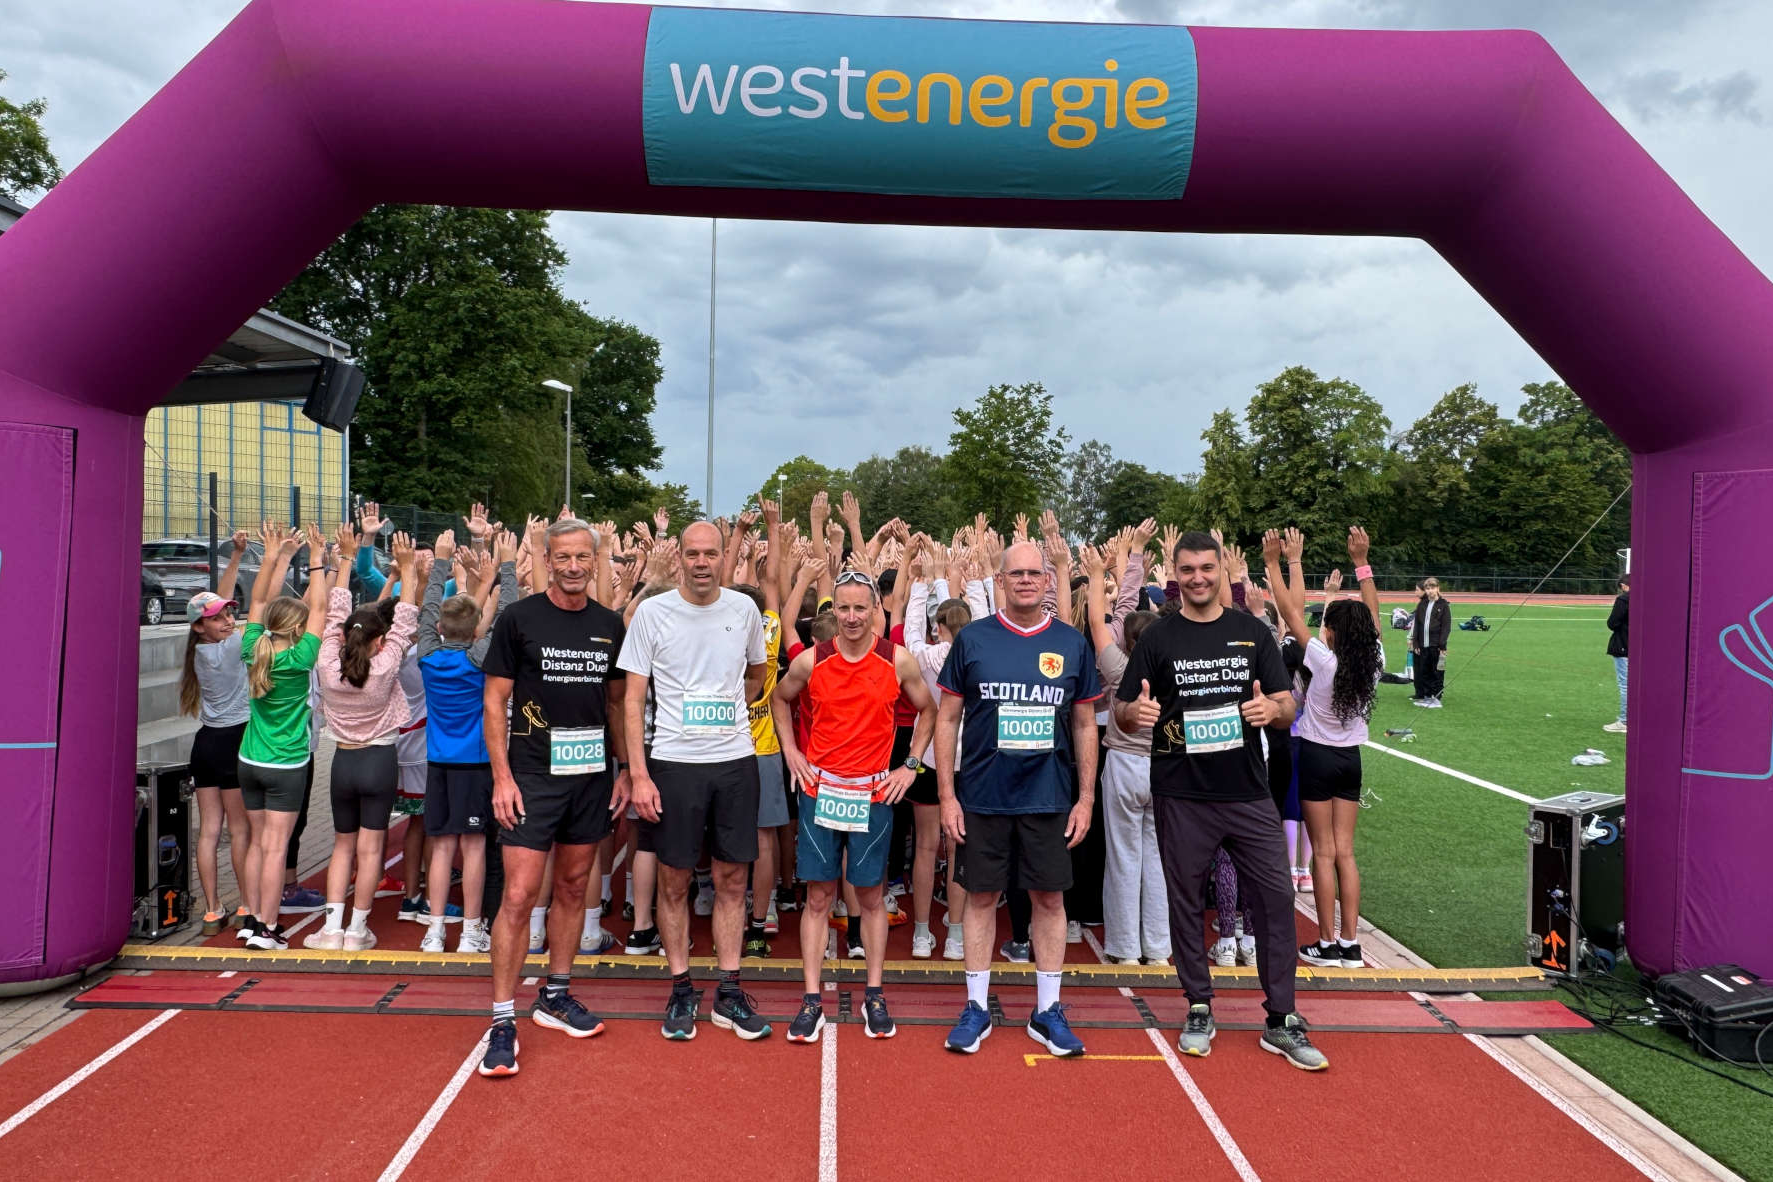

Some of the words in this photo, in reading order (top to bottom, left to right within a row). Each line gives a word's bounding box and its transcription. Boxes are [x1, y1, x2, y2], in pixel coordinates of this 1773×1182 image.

[669, 56, 1170, 149] westenergie
[541, 647, 608, 661] Westenergie
[541, 659, 584, 671] Distanz
[1173, 655, 1249, 672] Westenergie
[1175, 672, 1220, 685] Distanz
[1221, 668, 1250, 681] Duell
[979, 682, 1065, 705] SCOTLAND
[685, 705, 735, 721] 10000
[1000, 719, 1054, 736] 10003
[1188, 719, 1239, 740] 10001
[552, 742, 604, 761] 10028
[818, 798, 869, 819] 10005
